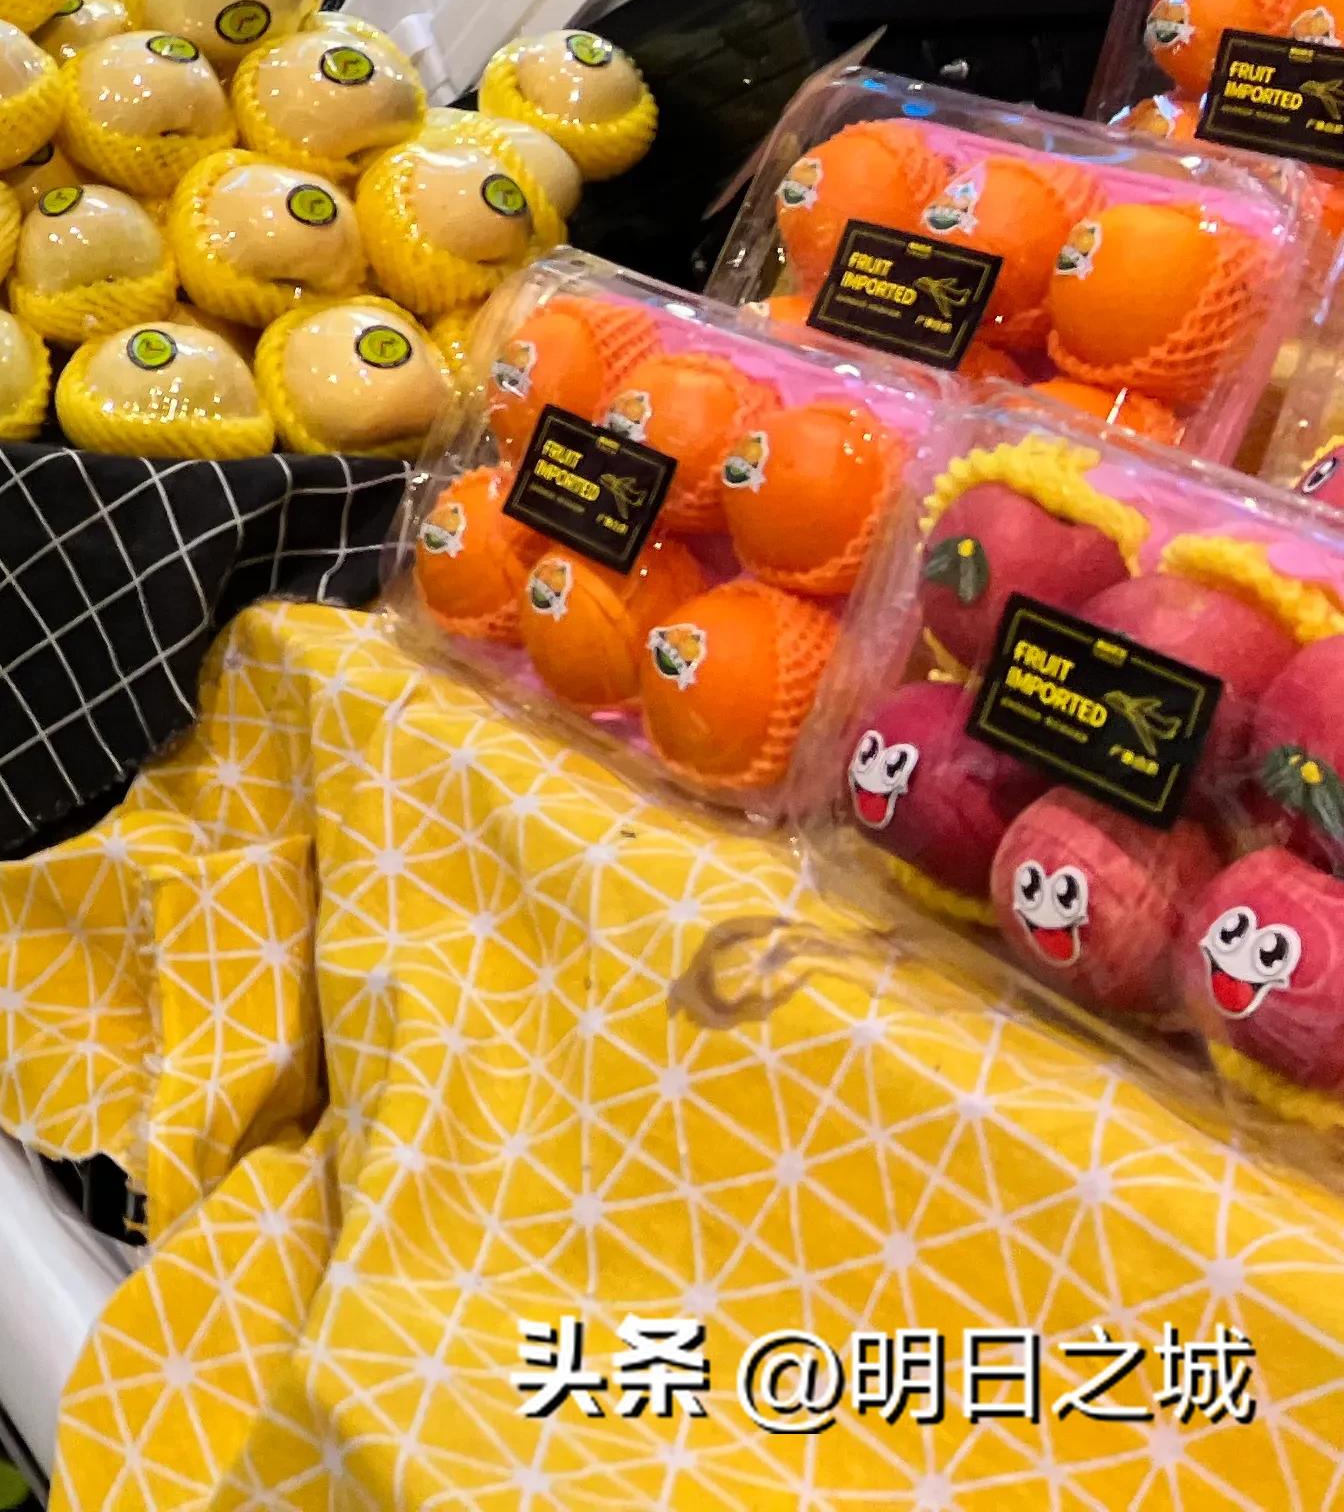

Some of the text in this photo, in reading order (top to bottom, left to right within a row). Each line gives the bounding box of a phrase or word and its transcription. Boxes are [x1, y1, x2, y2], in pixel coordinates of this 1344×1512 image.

[1229, 60, 1277, 83] FRUIT
[1223, 80, 1304, 110] IMPORTED
[848, 251, 893, 276] FRUIT
[840, 271, 918, 305] IMPORTED
[1014, 640, 1076, 681] FRUIT
[1005, 666, 1108, 728] IMPORTED
